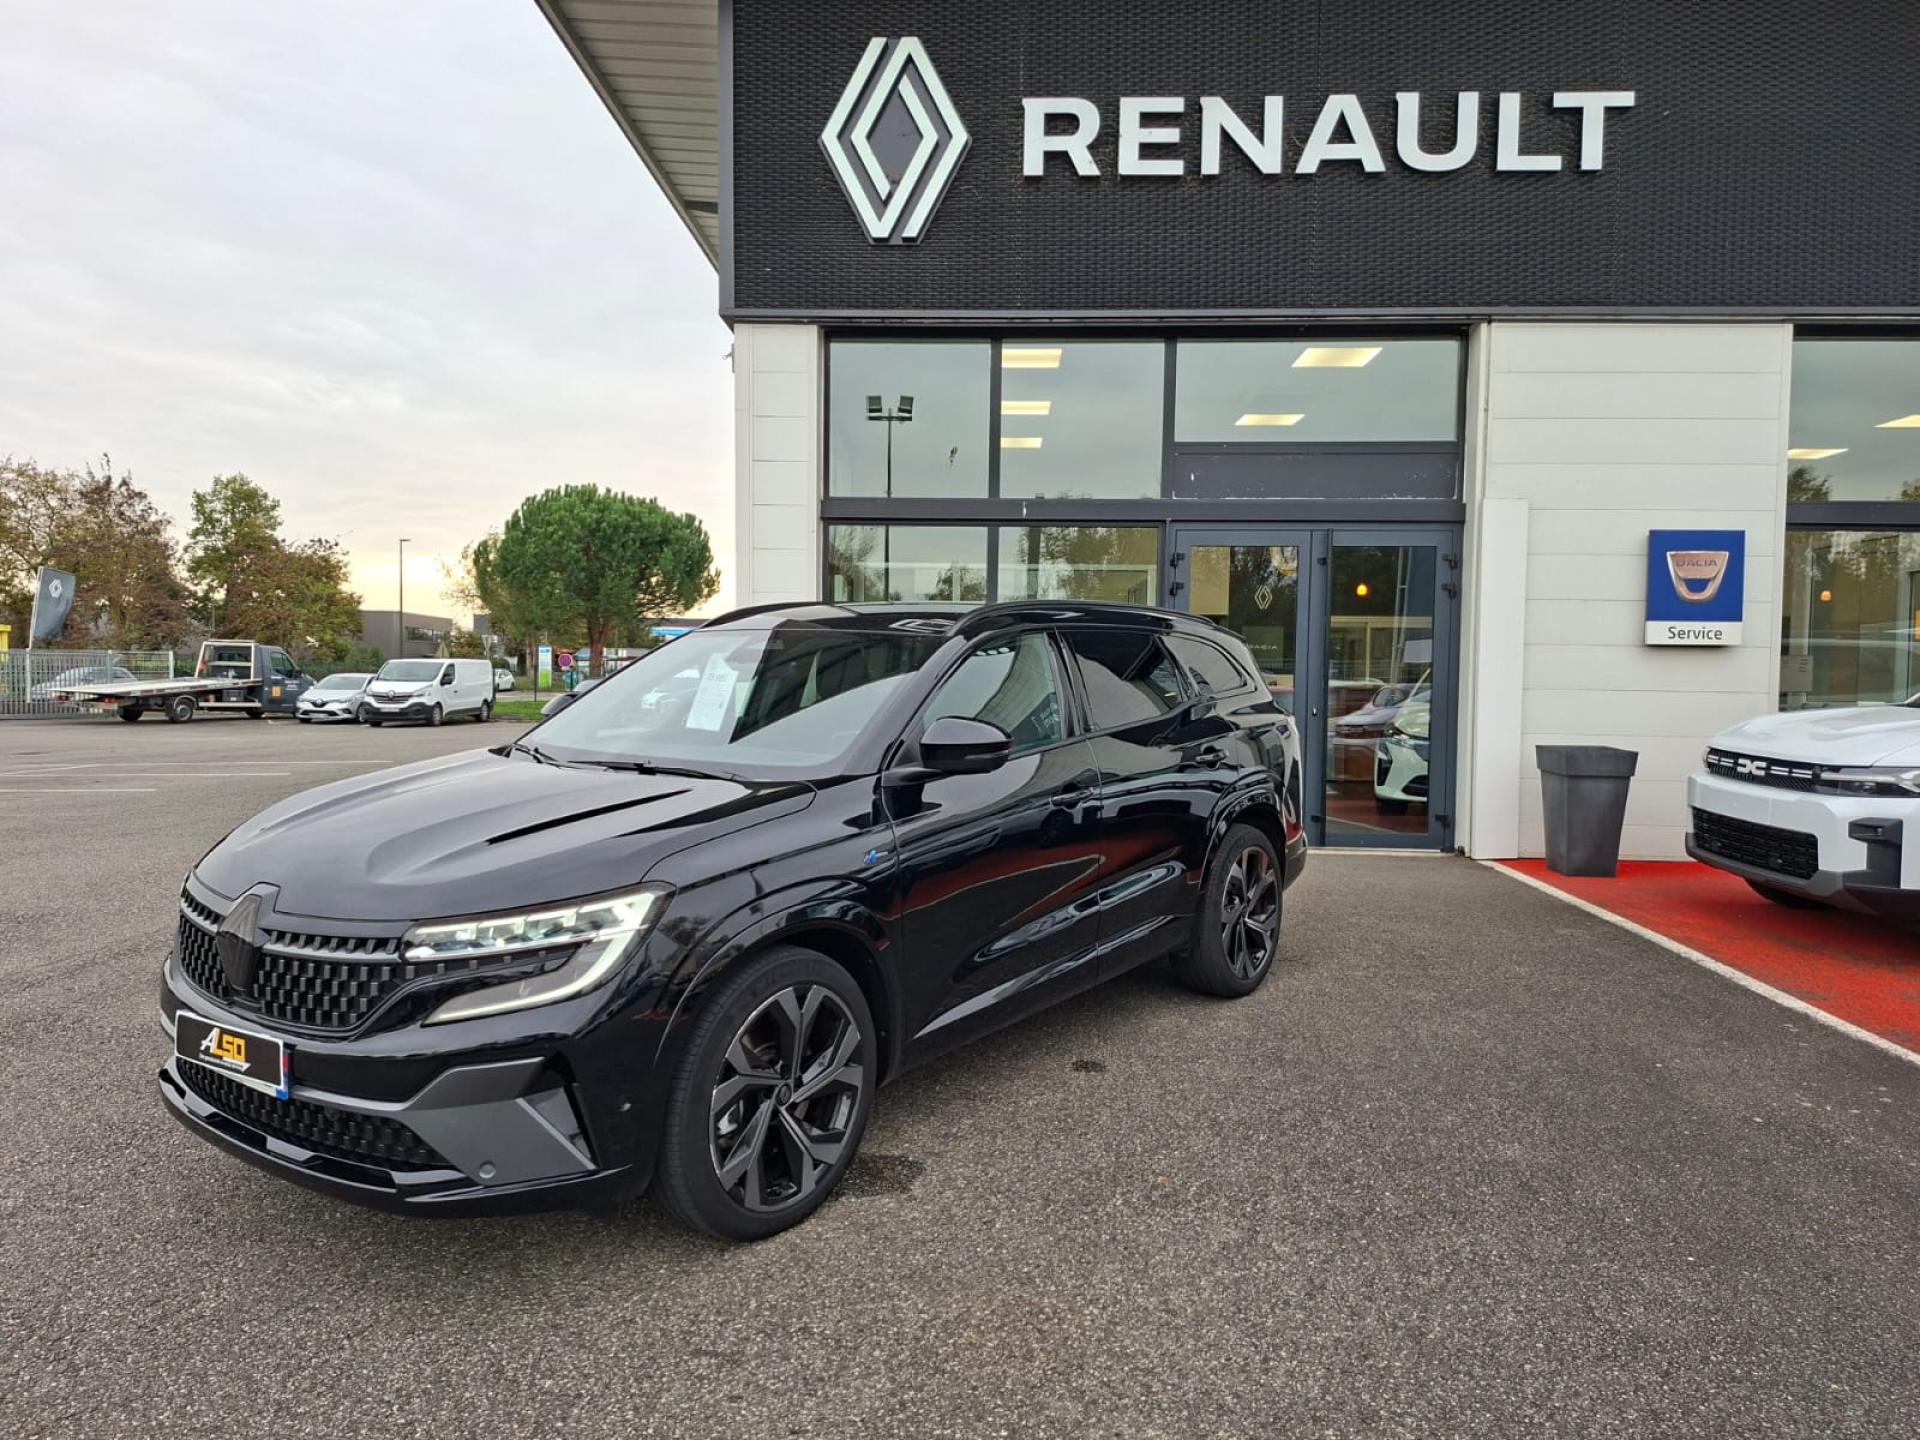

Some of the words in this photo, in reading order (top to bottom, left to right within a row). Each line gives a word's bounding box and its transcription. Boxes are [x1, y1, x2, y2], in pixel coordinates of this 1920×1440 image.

[1022, 91, 1636, 177] RENAULT
[1675, 558, 1719, 568] DACIA
[1667, 626, 1723, 640] Service
